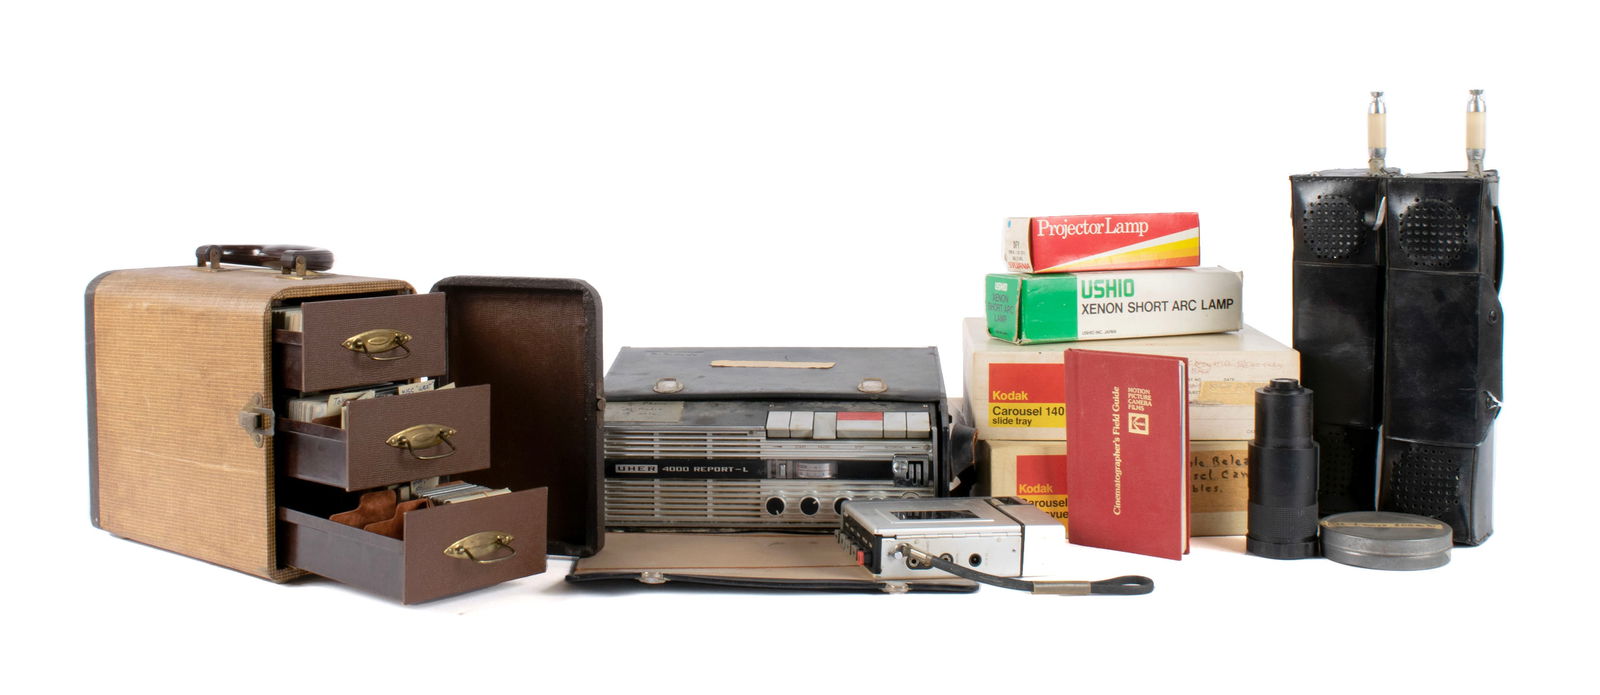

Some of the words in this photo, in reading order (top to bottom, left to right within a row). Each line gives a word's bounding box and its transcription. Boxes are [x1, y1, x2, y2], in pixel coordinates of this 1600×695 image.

[1037, 219, 1104, 239] Projector
[1104, 217, 1149, 237] Lamp
[1081, 278, 1135, 299] USHIO
[1082, 302, 1124, 315] XENON
[1127, 301, 1168, 313] SHORT
[1171, 299, 1197, 312] ARC
[1201, 298, 1234, 310] LAMP
[992, 390, 1028, 401] Kodak
[1112, 386, 1120, 412] Guide
[1128, 393, 1152, 401] PICTURE
[1128, 399, 1152, 407] CAMERA
[992, 406, 1042, 416] Carousel
[1046, 406, 1065, 416] 140
[992, 417, 1013, 425] slide
[1016, 417, 1032, 427] tray
[1112, 414, 1120, 435] Field
[1212, 454, 1249, 466] Relea
[616, 465, 657, 473] UHER
[1193, 469, 1213, 480] sel
[1113, 437, 1122, 515] Cinematographer's
[1019, 484, 1053, 493] Kodak
[1192, 484, 1223, 493] bles.
[1046, 511, 1069, 519] vue
